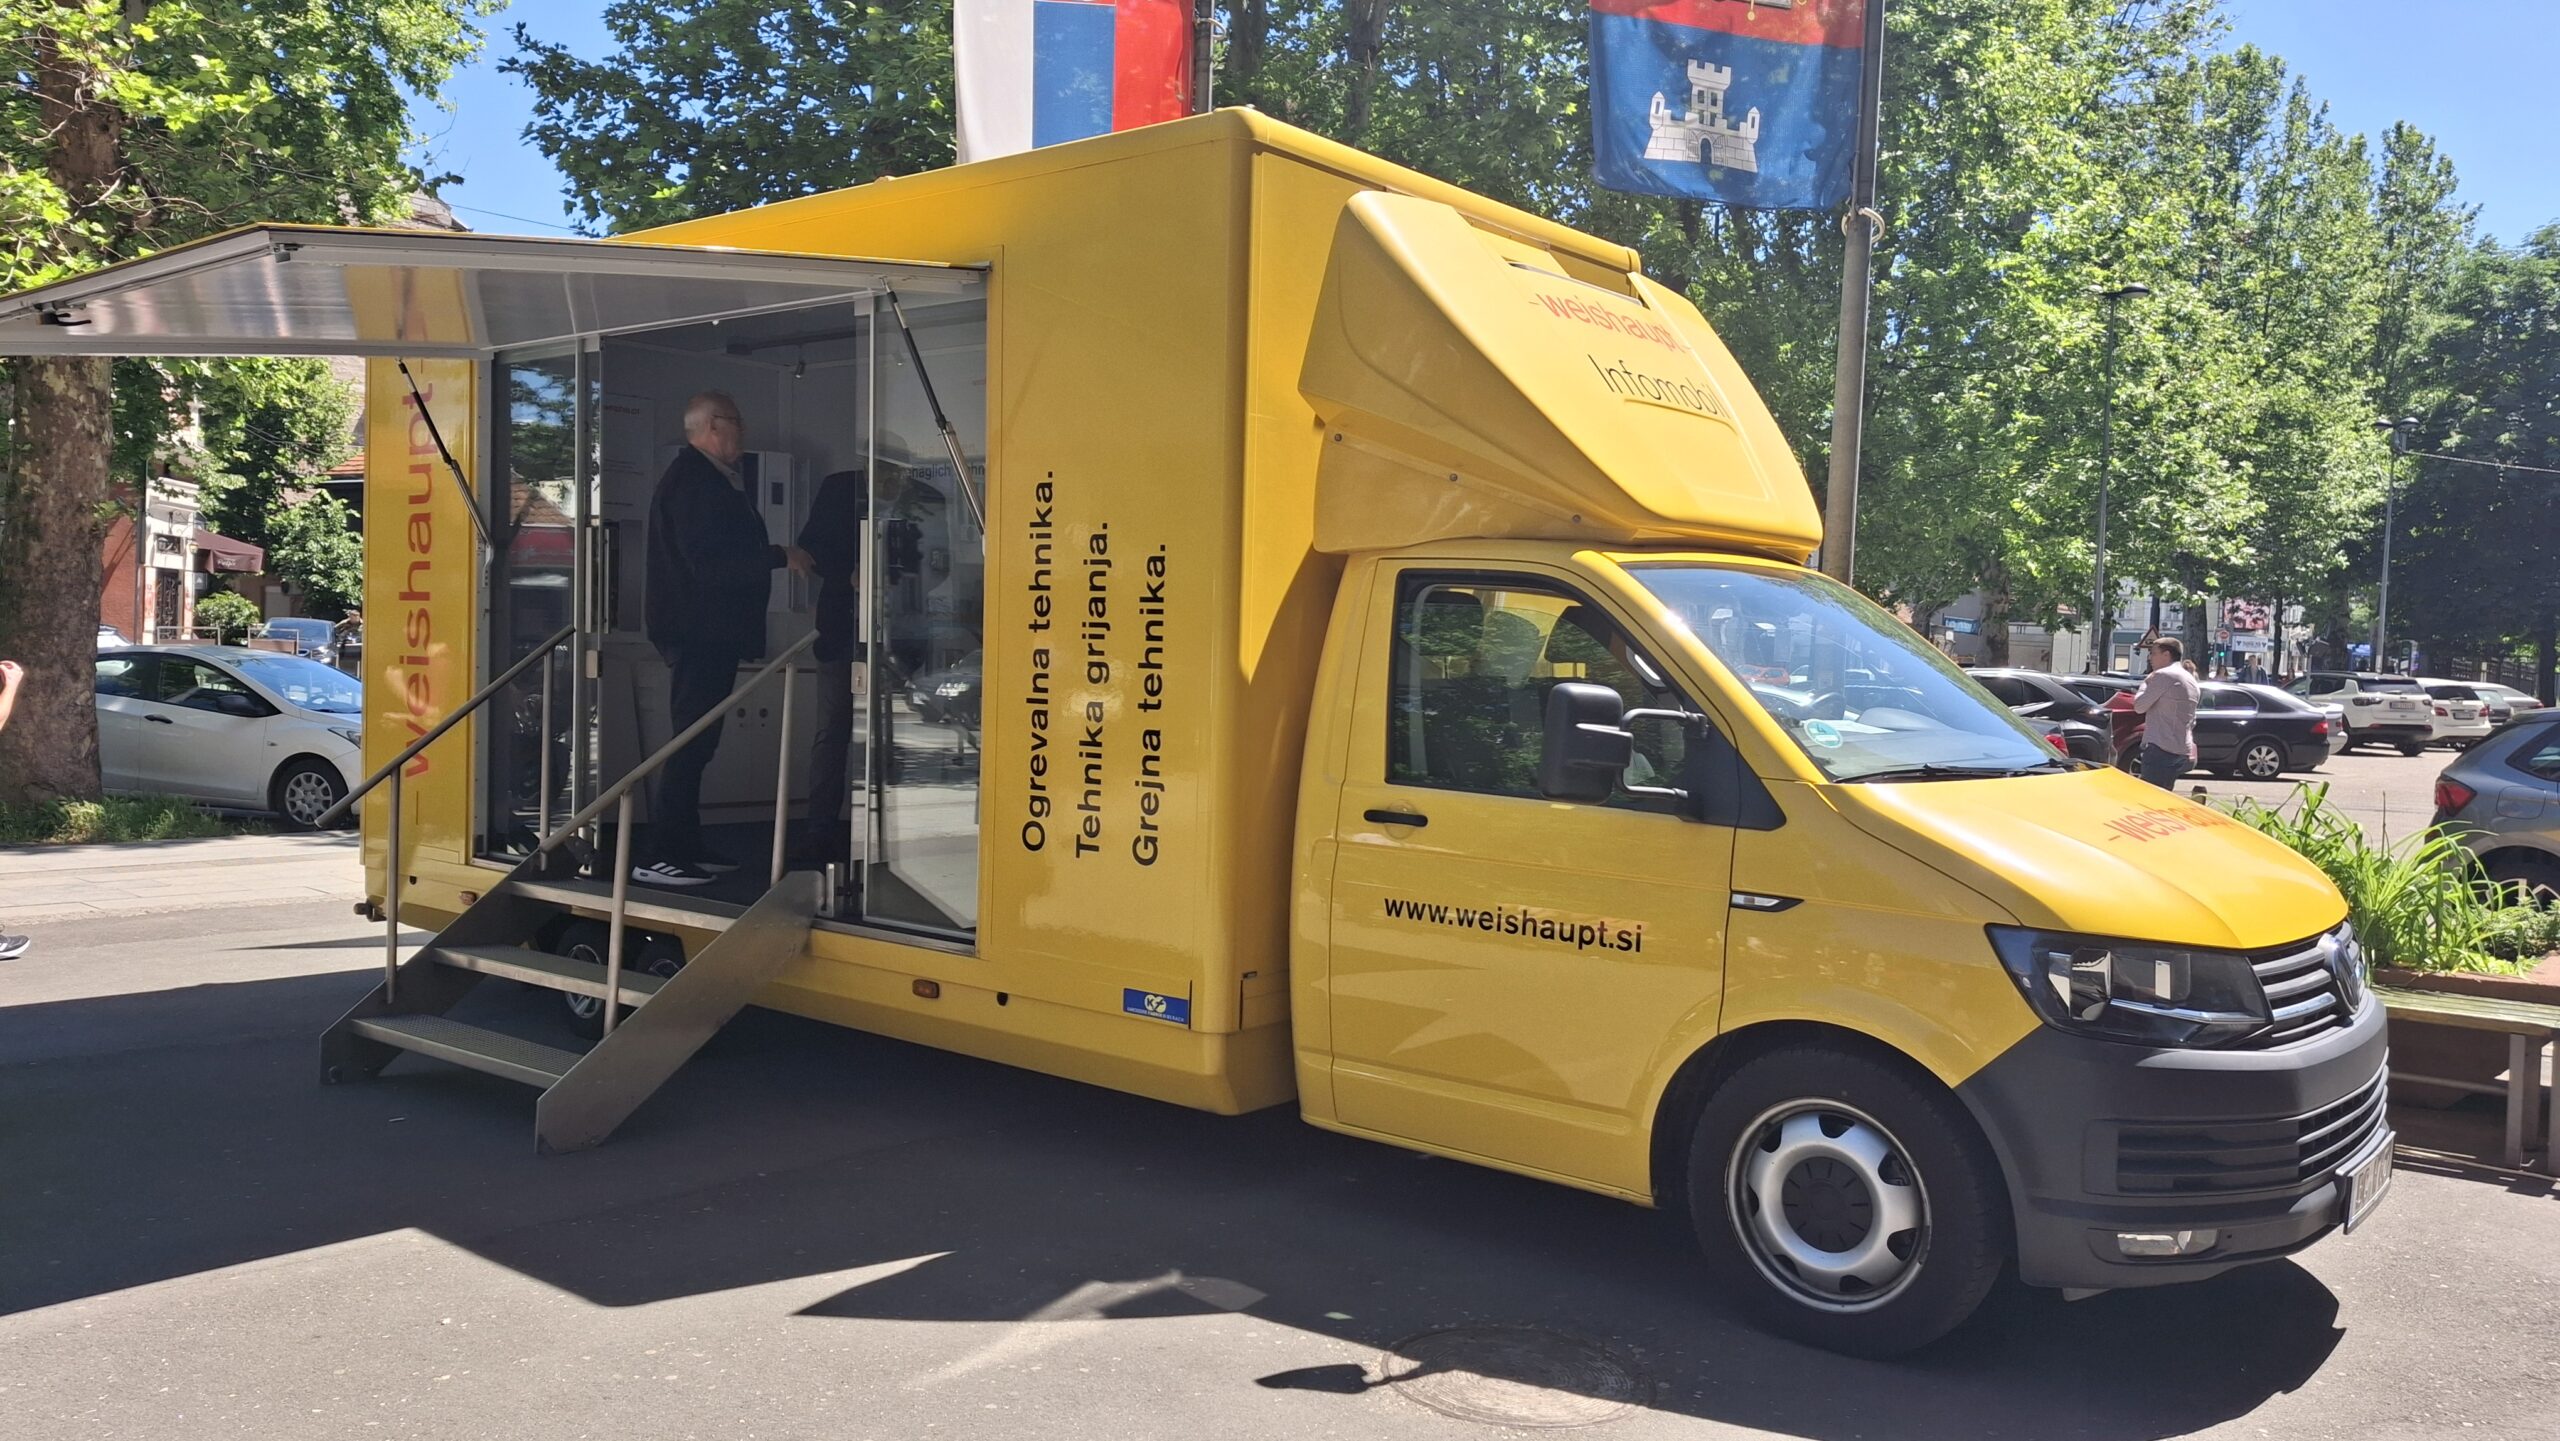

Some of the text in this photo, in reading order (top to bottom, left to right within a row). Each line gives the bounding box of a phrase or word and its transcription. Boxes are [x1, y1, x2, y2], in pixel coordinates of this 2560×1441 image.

[1587, 353, 1732, 419] Infomobil
[1022, 470, 1054, 851] Ogrevalna tehnika.
[1076, 522, 1112, 858] Tehnika grijanja.
[1132, 544, 1167, 866] Grejna tehnika.
[1384, 897, 1643, 953] www.weishaupt.si
